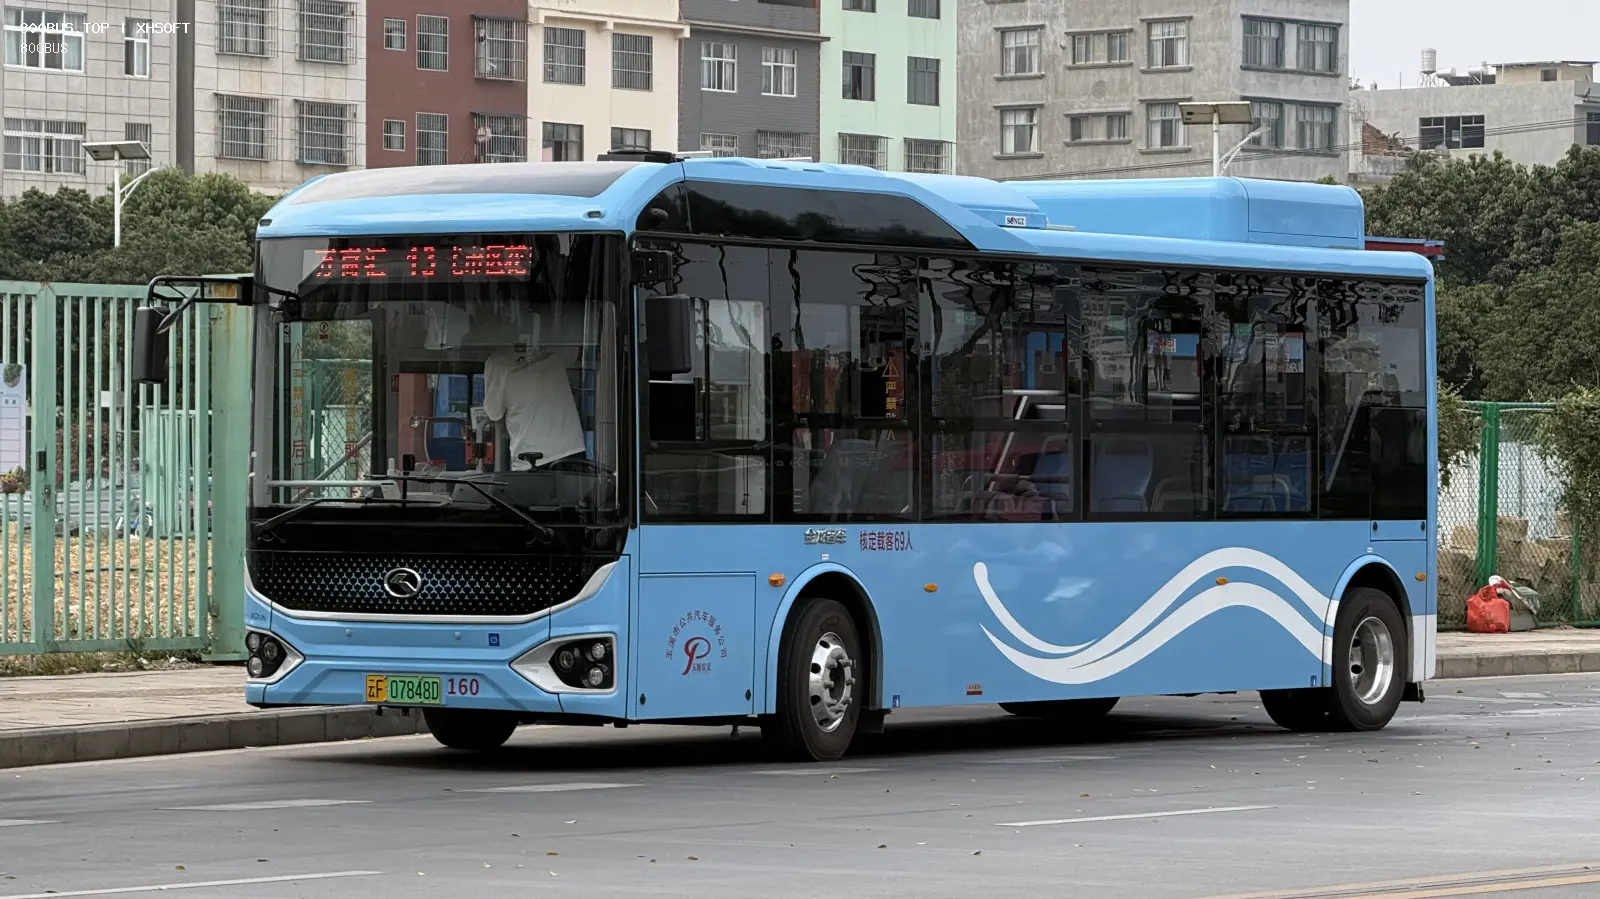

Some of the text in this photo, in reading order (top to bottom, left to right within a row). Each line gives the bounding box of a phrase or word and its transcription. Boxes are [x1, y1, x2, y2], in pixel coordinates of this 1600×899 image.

[859, 530, 914, 552] 核定载客69人
[447, 678, 479, 696] 160
